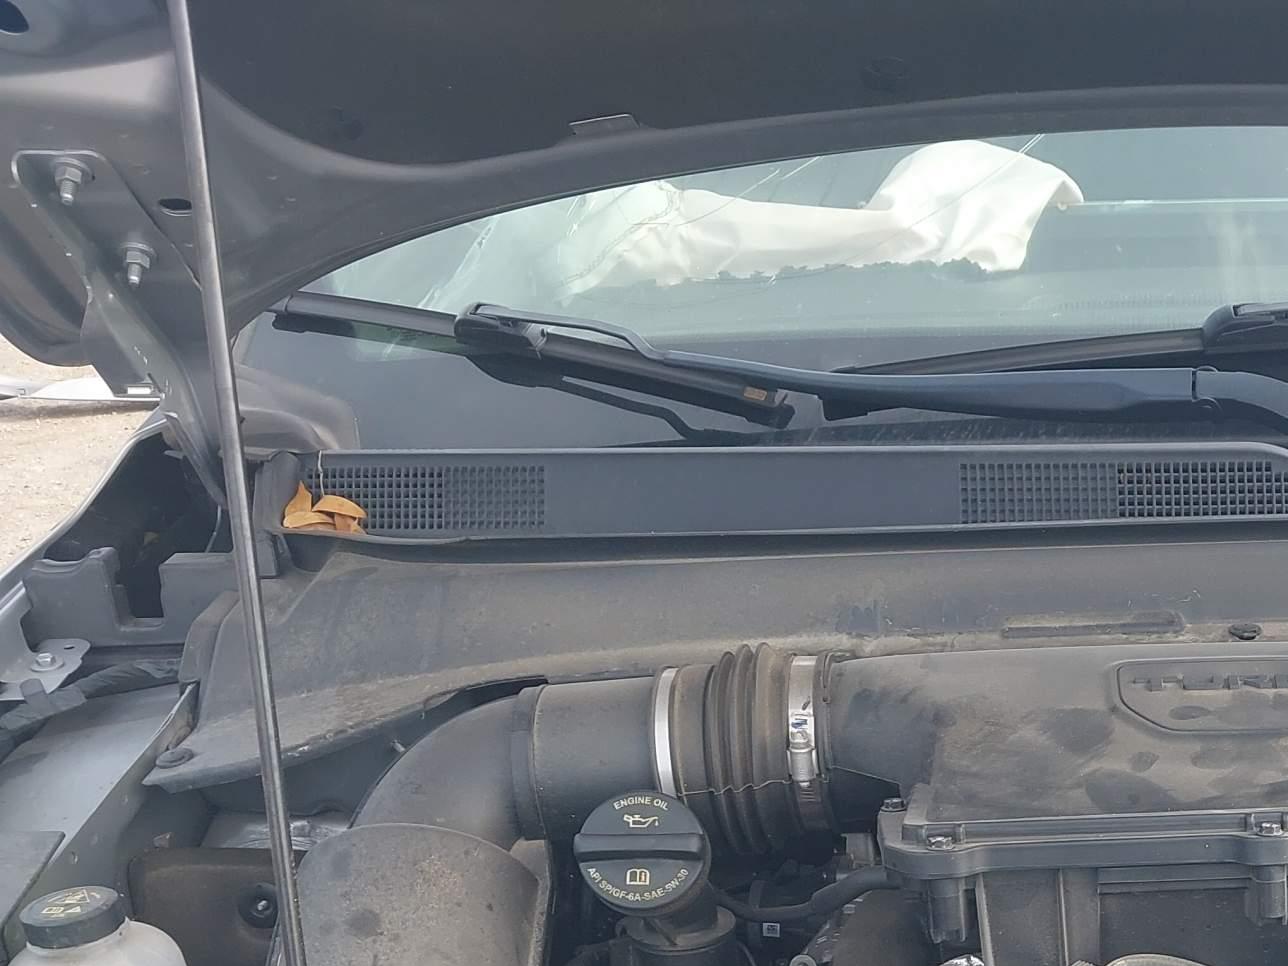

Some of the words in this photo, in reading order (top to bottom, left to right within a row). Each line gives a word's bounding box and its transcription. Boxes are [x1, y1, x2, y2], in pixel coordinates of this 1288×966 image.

[613, 796, 651, 810] ENGINE
[653, 798, 670, 811] OIL
[587, 867, 600, 883] API
